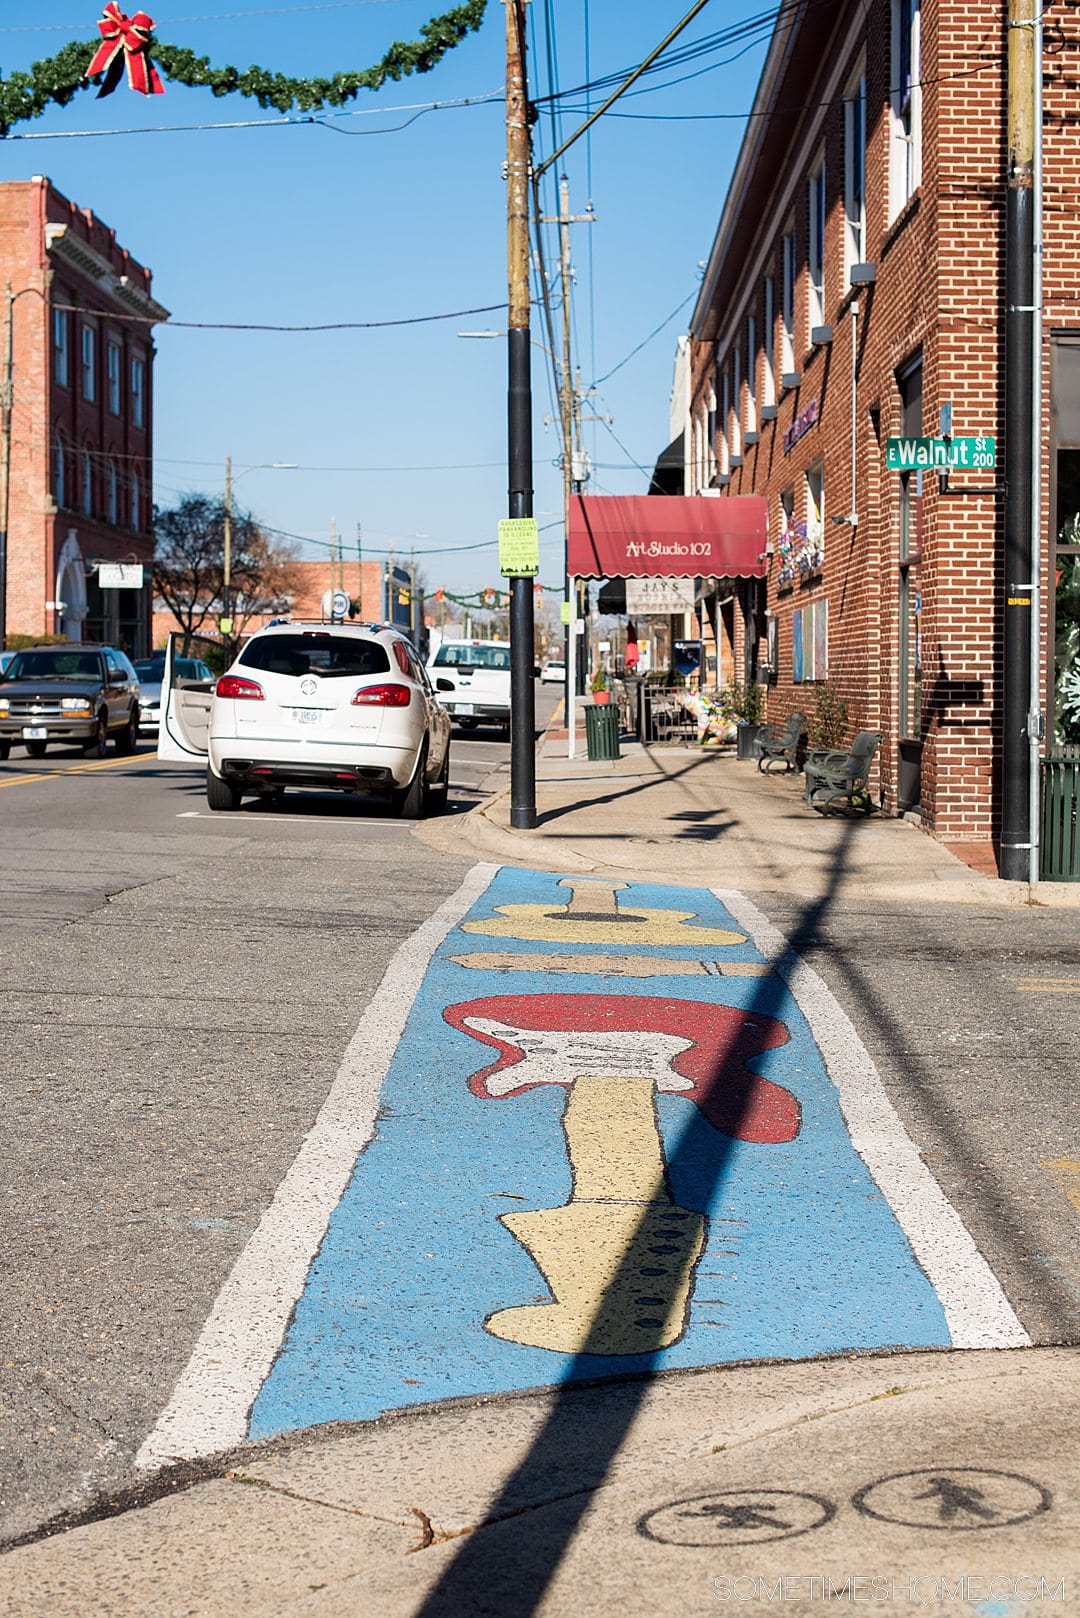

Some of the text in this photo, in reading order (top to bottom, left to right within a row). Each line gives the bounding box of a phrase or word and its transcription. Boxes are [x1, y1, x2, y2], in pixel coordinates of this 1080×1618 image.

[889, 437, 987, 465] E Walnut St
[972, 453, 994, 467] 200
[626, 541, 712, 557] Art Studio 102
